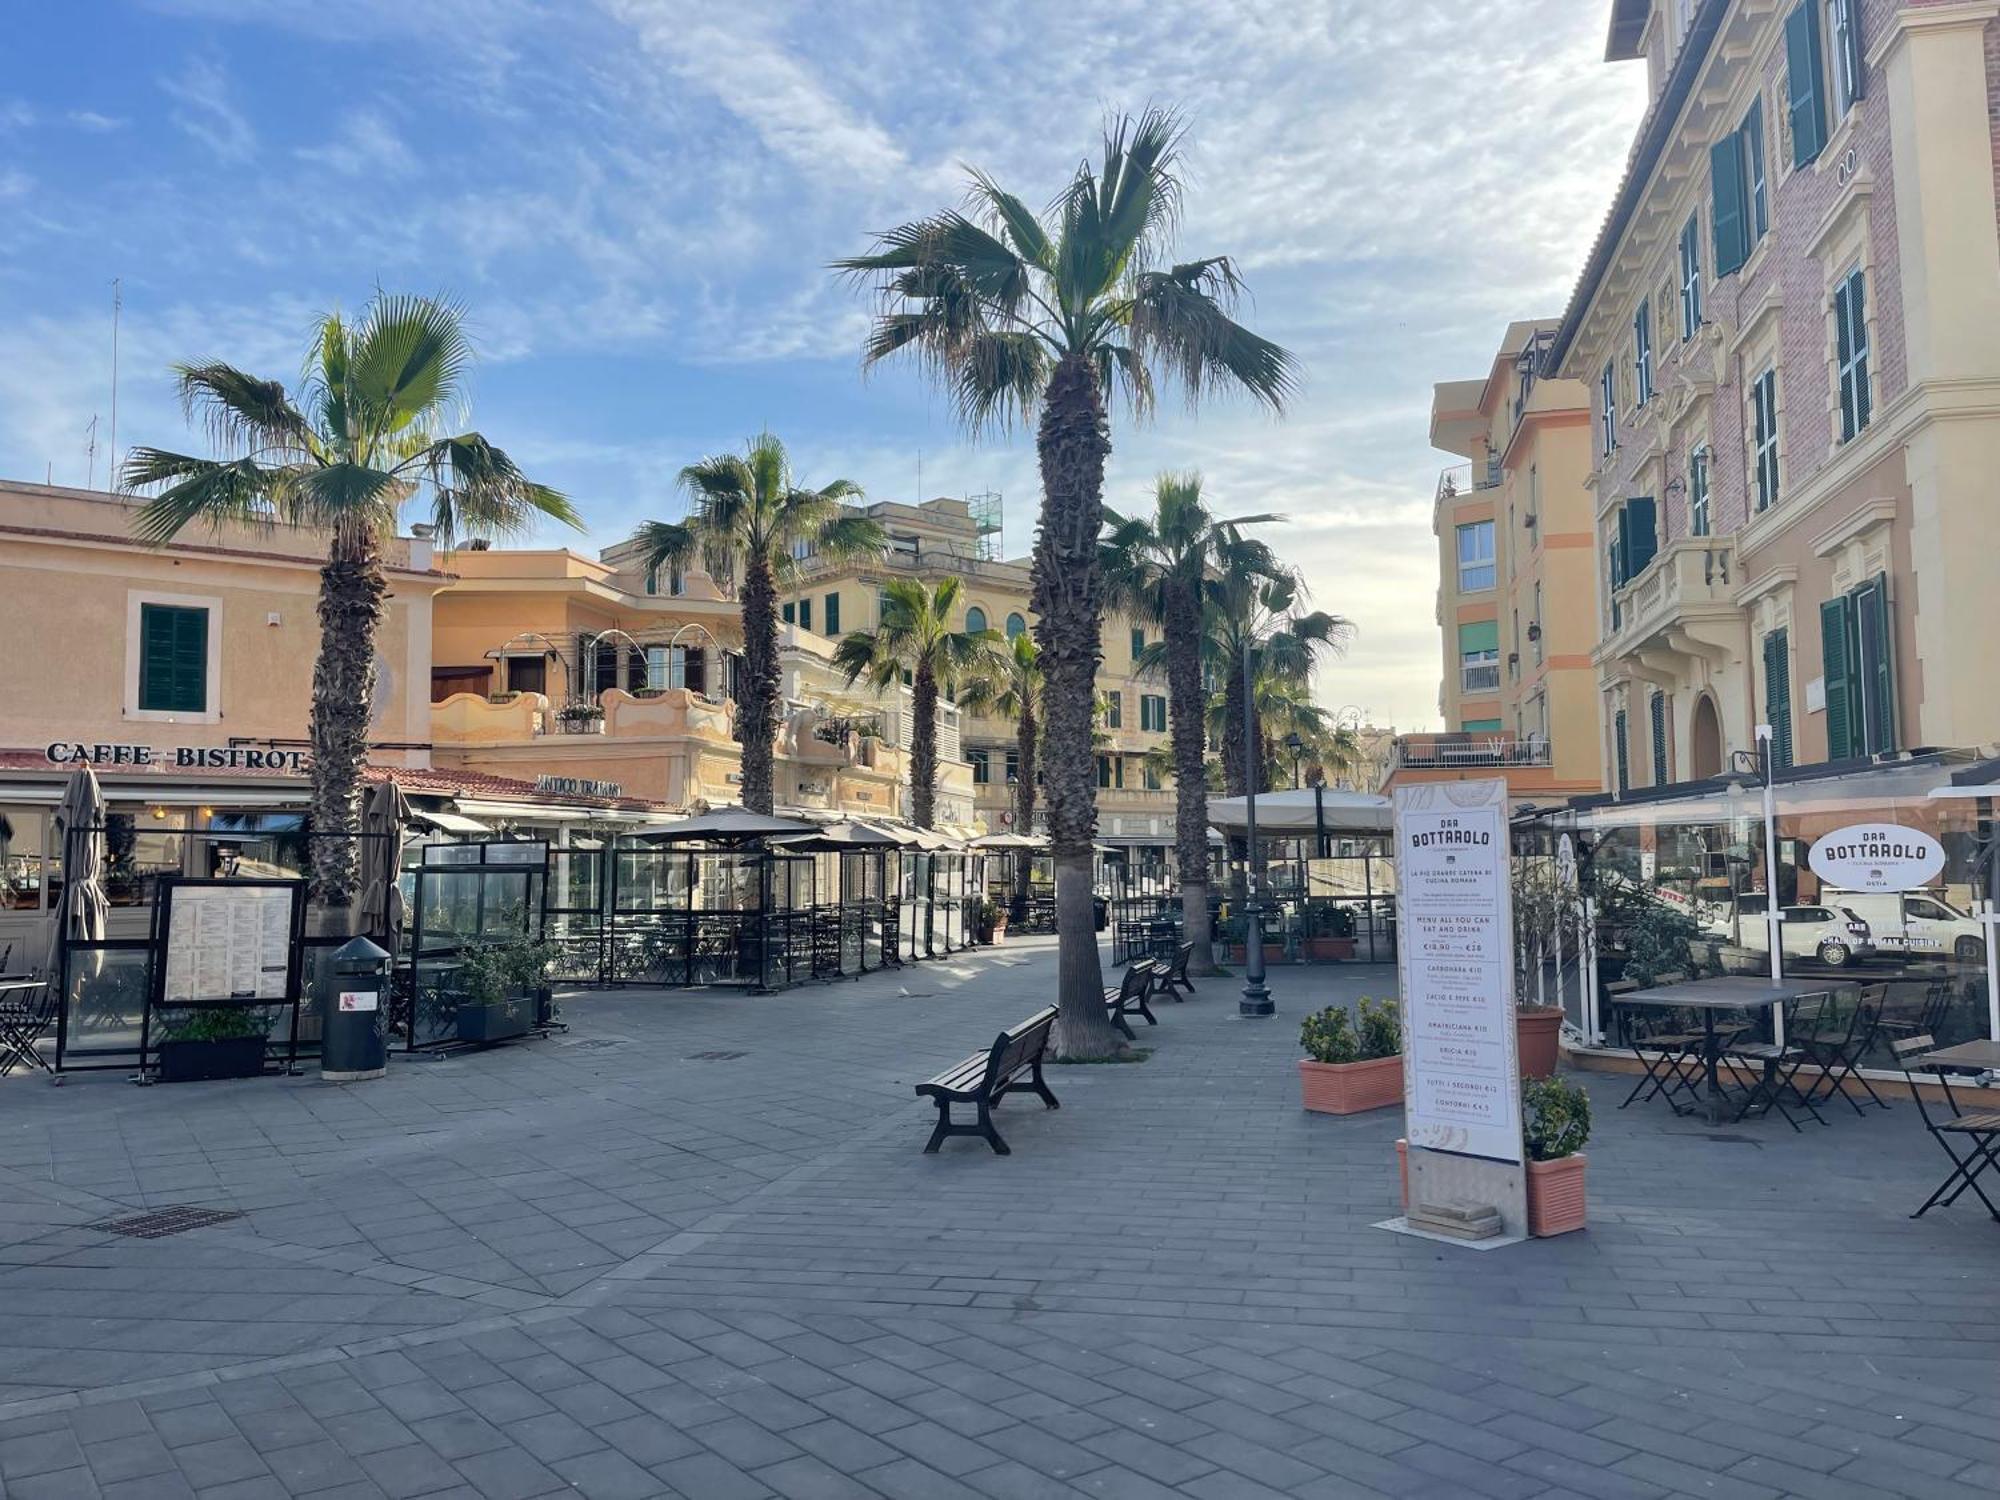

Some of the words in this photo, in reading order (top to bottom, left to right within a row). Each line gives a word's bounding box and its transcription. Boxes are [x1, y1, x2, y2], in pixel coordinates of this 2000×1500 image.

[176, 747, 305, 768] BISTROT
[1440, 819, 1459, 828] DAR
[1412, 830, 1489, 847] BOTTAROLO
[1863, 832, 1886, 841] DAR
[1825, 844, 1926, 861] BOTTAROLO
[1867, 938, 1899, 946] ROMAN
